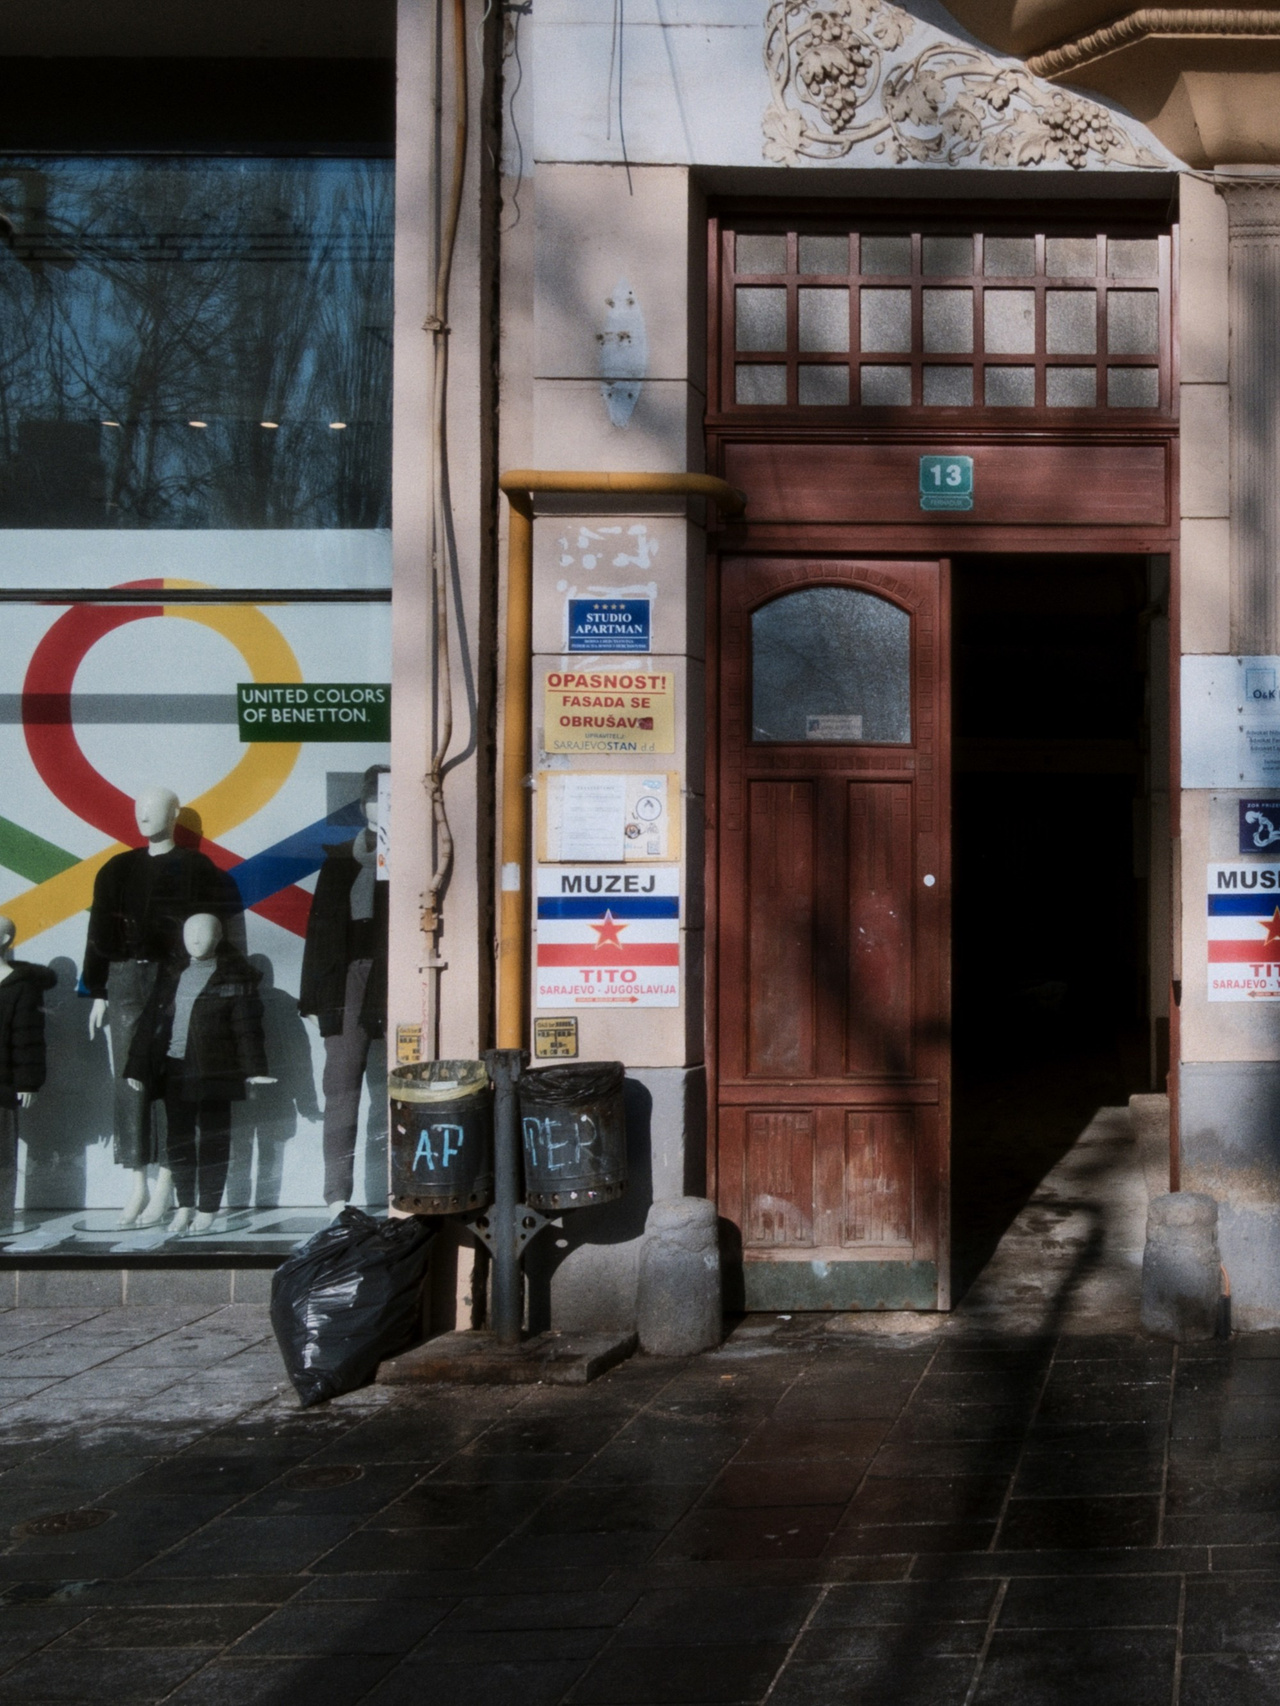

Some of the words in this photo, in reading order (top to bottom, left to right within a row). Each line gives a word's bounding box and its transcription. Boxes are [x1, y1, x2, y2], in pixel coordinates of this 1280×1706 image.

[930, 464, 962, 486] 13
[586, 613, 632, 623] STUDIO
[575, 625, 643, 634] APARTMAN
[547, 673, 666, 690] OPASNOST!
[242, 689, 309, 704] UNITED
[313, 689, 386, 703] COLORS
[1252, 689, 1276, 699] O&K
[562, 695, 625, 708] FASADA
[630, 697, 651, 709] SE
[243, 708, 267, 723] OF
[271, 708, 371, 723] BENETTON.
[559, 714, 654, 731] OBRUŠAV
[554, 740, 637, 751] SARAJEVOSTAN
[561, 875, 656, 893] MUZEJ
[579, 970, 638, 983] TITO
[539, 985, 594, 995] SARAJEVO
[604, 985, 676, 994] JUGOSLAVIJA
[1212, 979, 1267, 989] SARAJEVO
